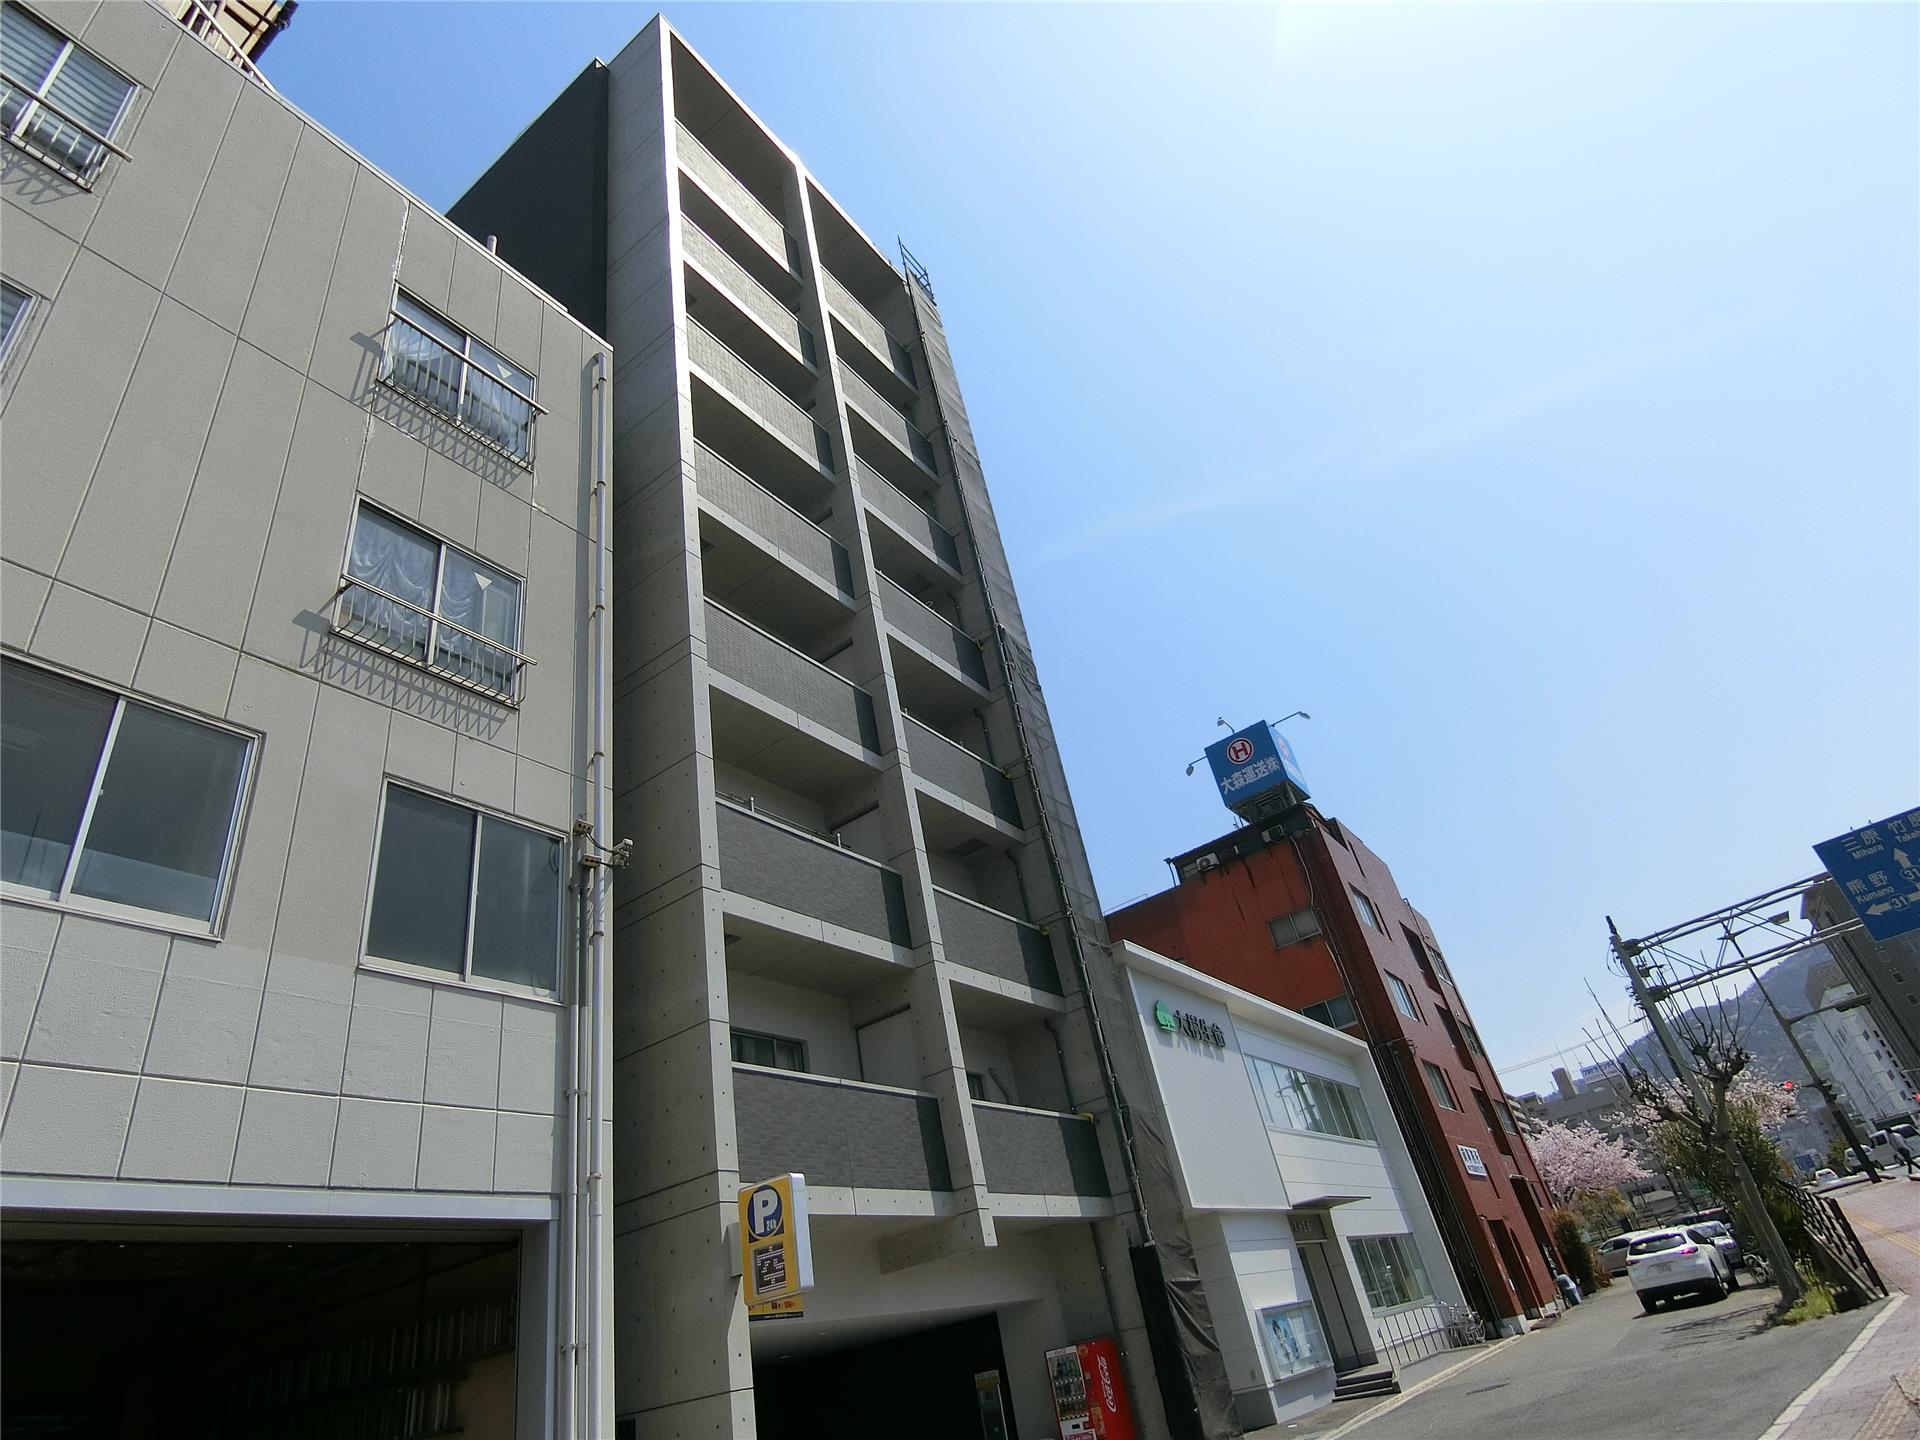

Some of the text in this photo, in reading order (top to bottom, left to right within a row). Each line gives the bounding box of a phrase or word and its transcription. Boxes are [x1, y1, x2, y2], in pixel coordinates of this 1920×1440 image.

[1231, 741, 1249, 760] H
[1841, 828, 1881, 852] 三原
[1852, 844, 1884, 860] Mihara
[1846, 871, 1887, 895] 熊野
[1856, 886, 1894, 903] Kumano
[1892, 895, 1908, 909] 31
[753, 1189, 778, 1234] P
